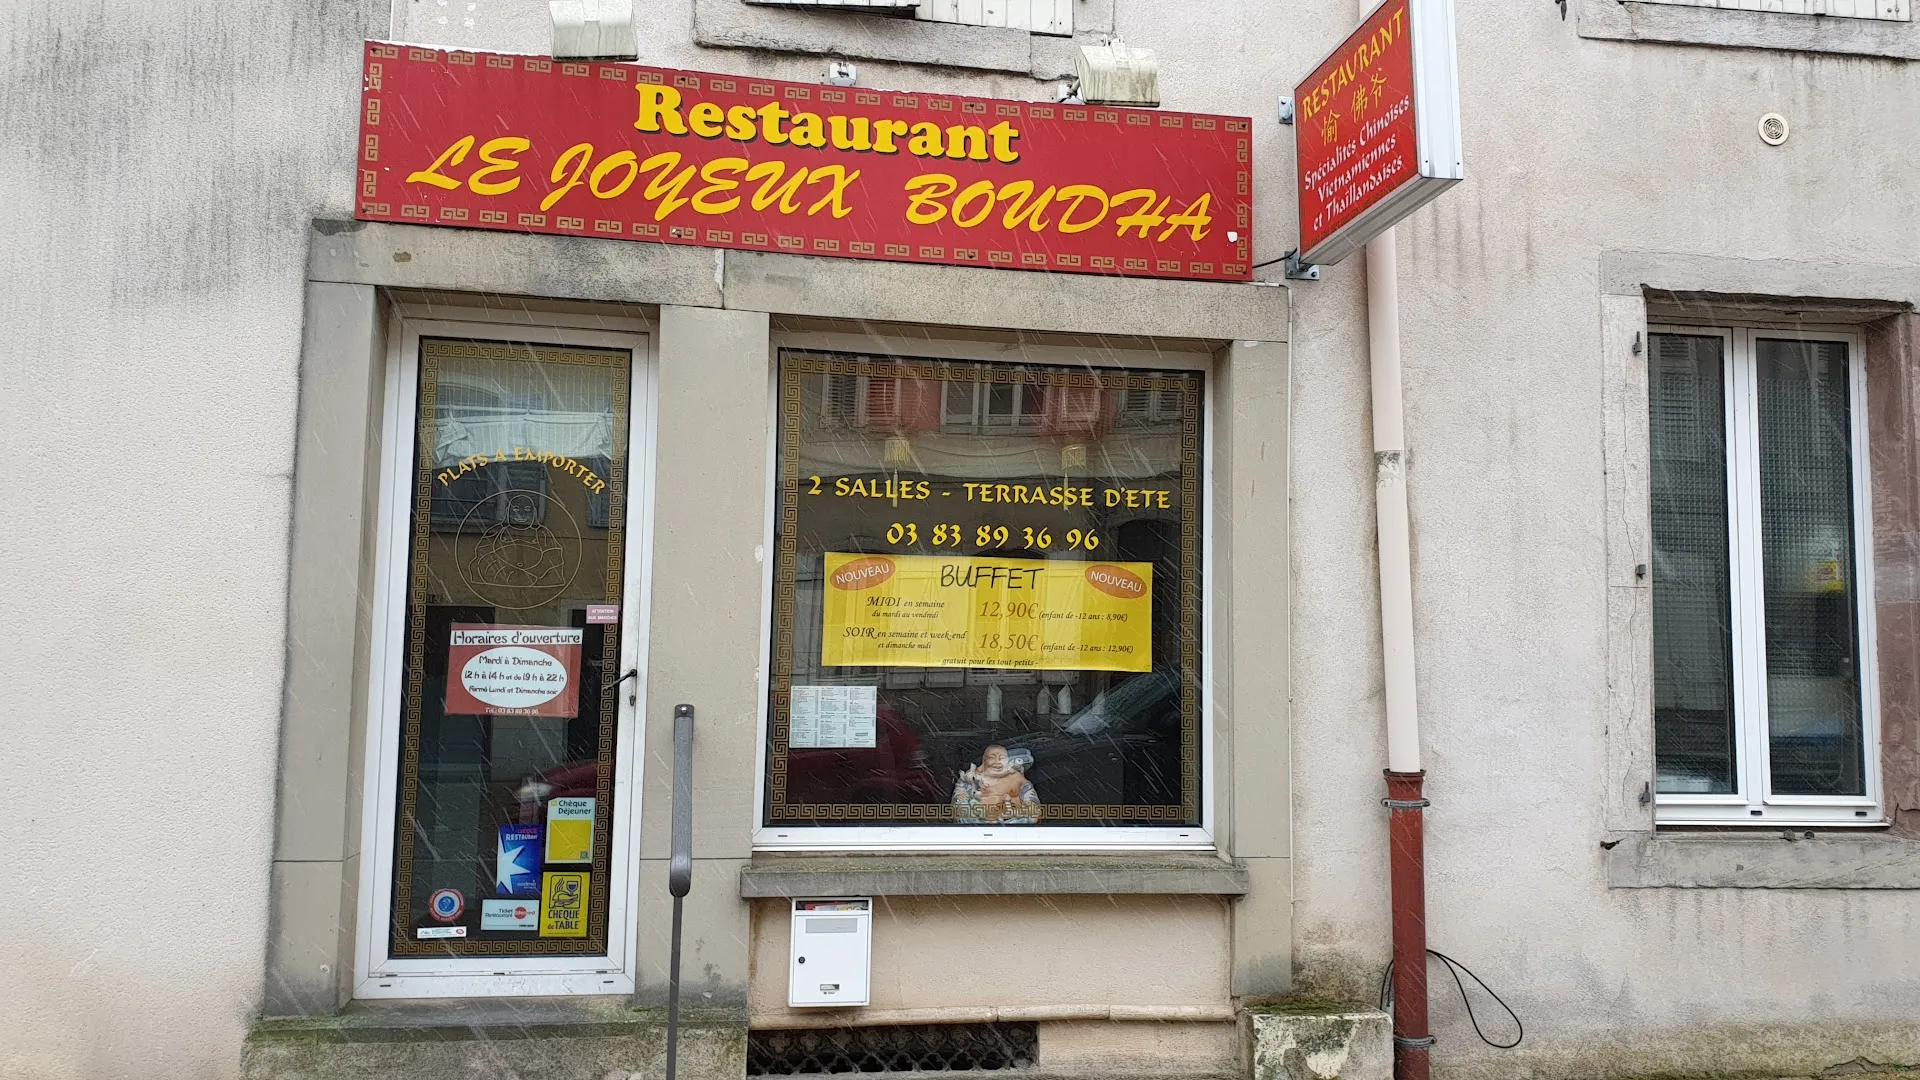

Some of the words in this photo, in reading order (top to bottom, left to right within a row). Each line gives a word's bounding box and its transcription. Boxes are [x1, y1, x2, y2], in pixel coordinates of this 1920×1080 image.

[1302, 6, 1404, 121] RESTAURANT
[634, 83, 1020, 163] Restaurant
[1304, 138, 1357, 190] Spécialités
[1359, 94, 1410, 147] Chinoises
[1317, 133, 1397, 203] Vietnamiennes
[405, 135, 530, 196] LE
[540, 142, 860, 222] JOYEUX
[904, 173, 1213, 243] BOUDHA
[1313, 212, 1323, 232] et
[437, 452, 489, 487] PLATS
[494, 448, 507, 462] A
[513, 447, 607, 495] EMPORTER
[807, 475, 823, 496] 2
[835, 477, 930, 500] SALLES
[962, 482, 1094, 507] TERRASSE
[1104, 487, 1172, 510] D'ETE
[886, 522, 918, 547] 03
[932, 523, 962, 547] 83
[975, 524, 1009, 548] 89
[1023, 526, 1052, 549] 36
[1066, 528, 1100, 550] 96
[835, 563, 890, 585] NOUVEAU
[940, 564, 1045, 589] BUFFET
[1090, 570, 1142, 593] NOUVEAU
[866, 596, 901, 607] MIDI
[914, 600, 944, 608] semaine
[979, 601, 1039, 620] 12,90€
[1038, 610, 1064, 620] (enfant
[1106, 613, 1128, 622] 8,90€)
[454, 630, 508, 644] Horaires
[511, 631, 580, 644] d'ouverture
[843, 626, 877, 639] SOIR
[930, 630, 968, 640] week-end
[979, 633, 1039, 652] 18,50€
[1040, 644, 1065, 652] (enfant
[479, 656, 503, 665] Mardi
[512, 657, 552, 666] Dimanche
[942, 657, 966, 665] gratuit
[997, 658, 1035, 666] tout-petits
[464, 671, 473, 679] 12
[474, 671, 479, 679] h
[488, 672, 497, 680] 14
[499, 671, 504, 680] h
[522, 673, 531, 681] 19
[548, 910, 579, 919] CHEQUE
[554, 920, 579, 929] TABLE
